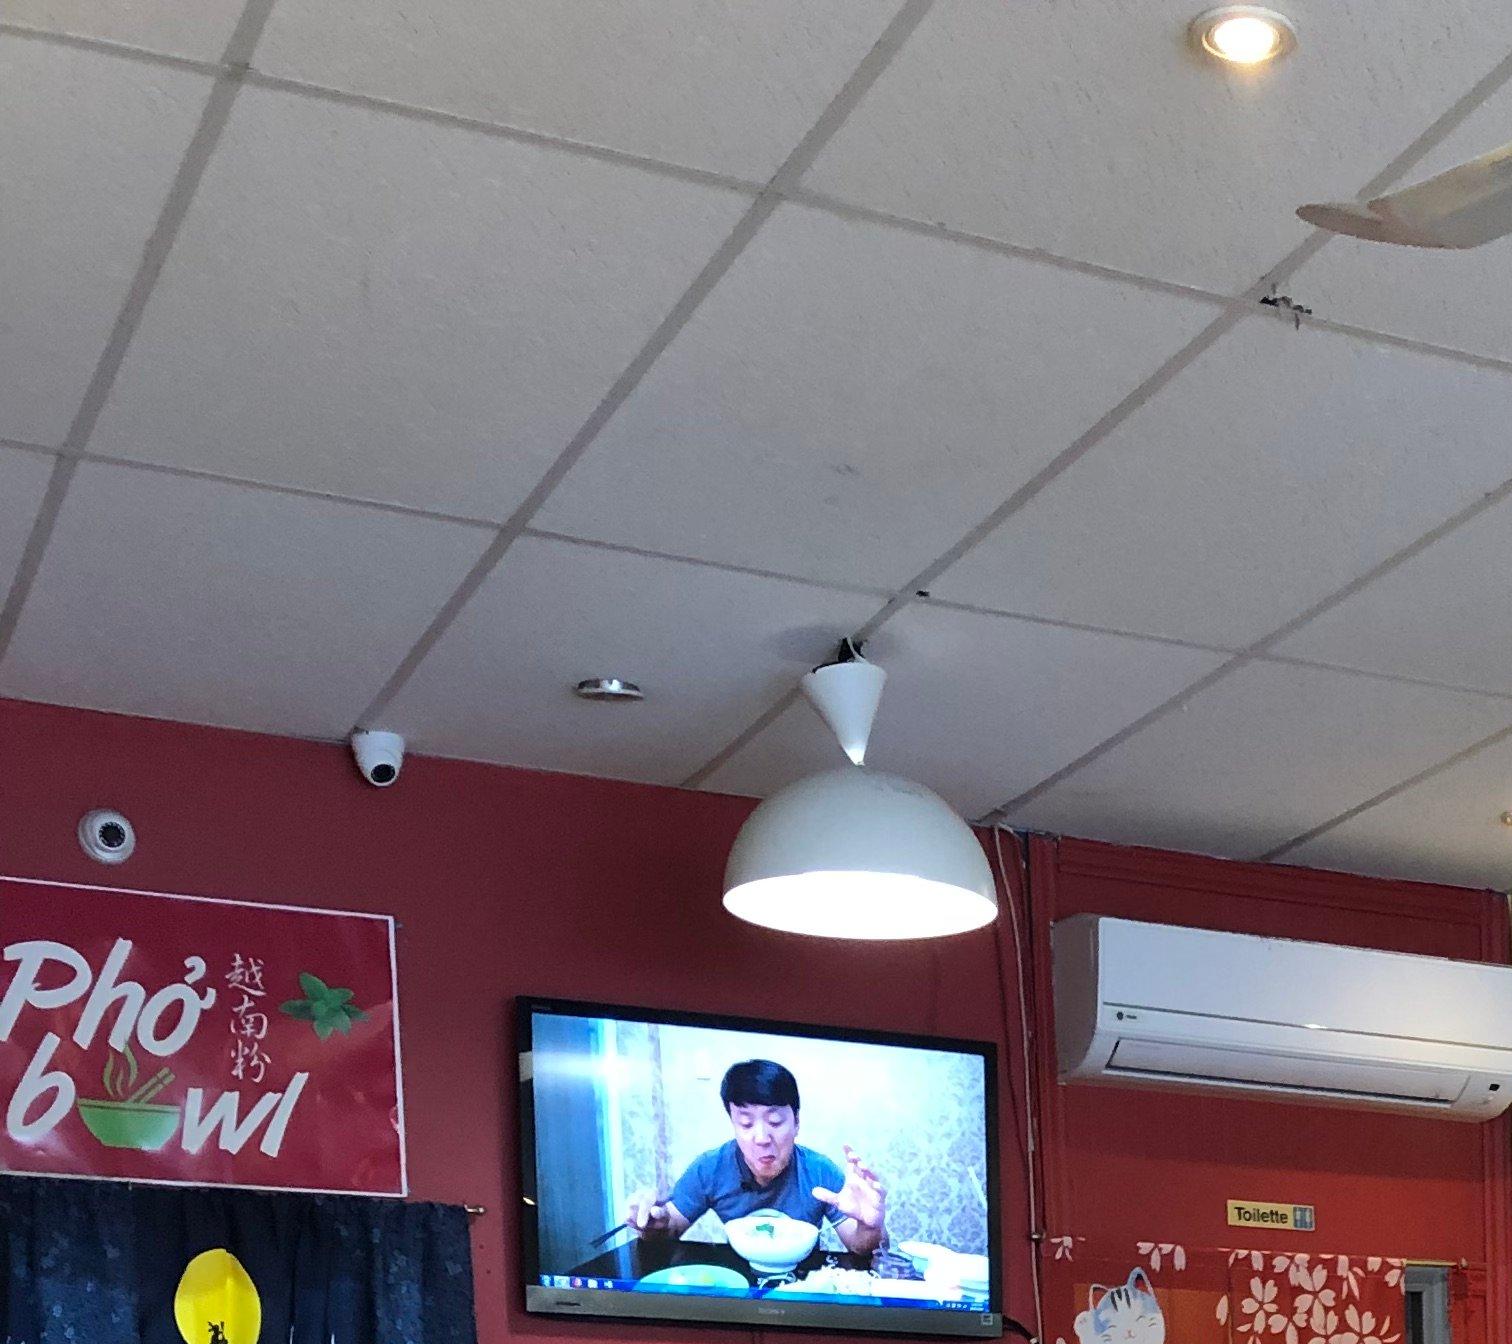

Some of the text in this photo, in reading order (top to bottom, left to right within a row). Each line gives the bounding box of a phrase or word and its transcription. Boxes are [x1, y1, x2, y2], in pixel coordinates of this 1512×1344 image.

[225, 953, 272, 1083] 越南粉
[1234, 1206, 1288, 1224] Toilette
